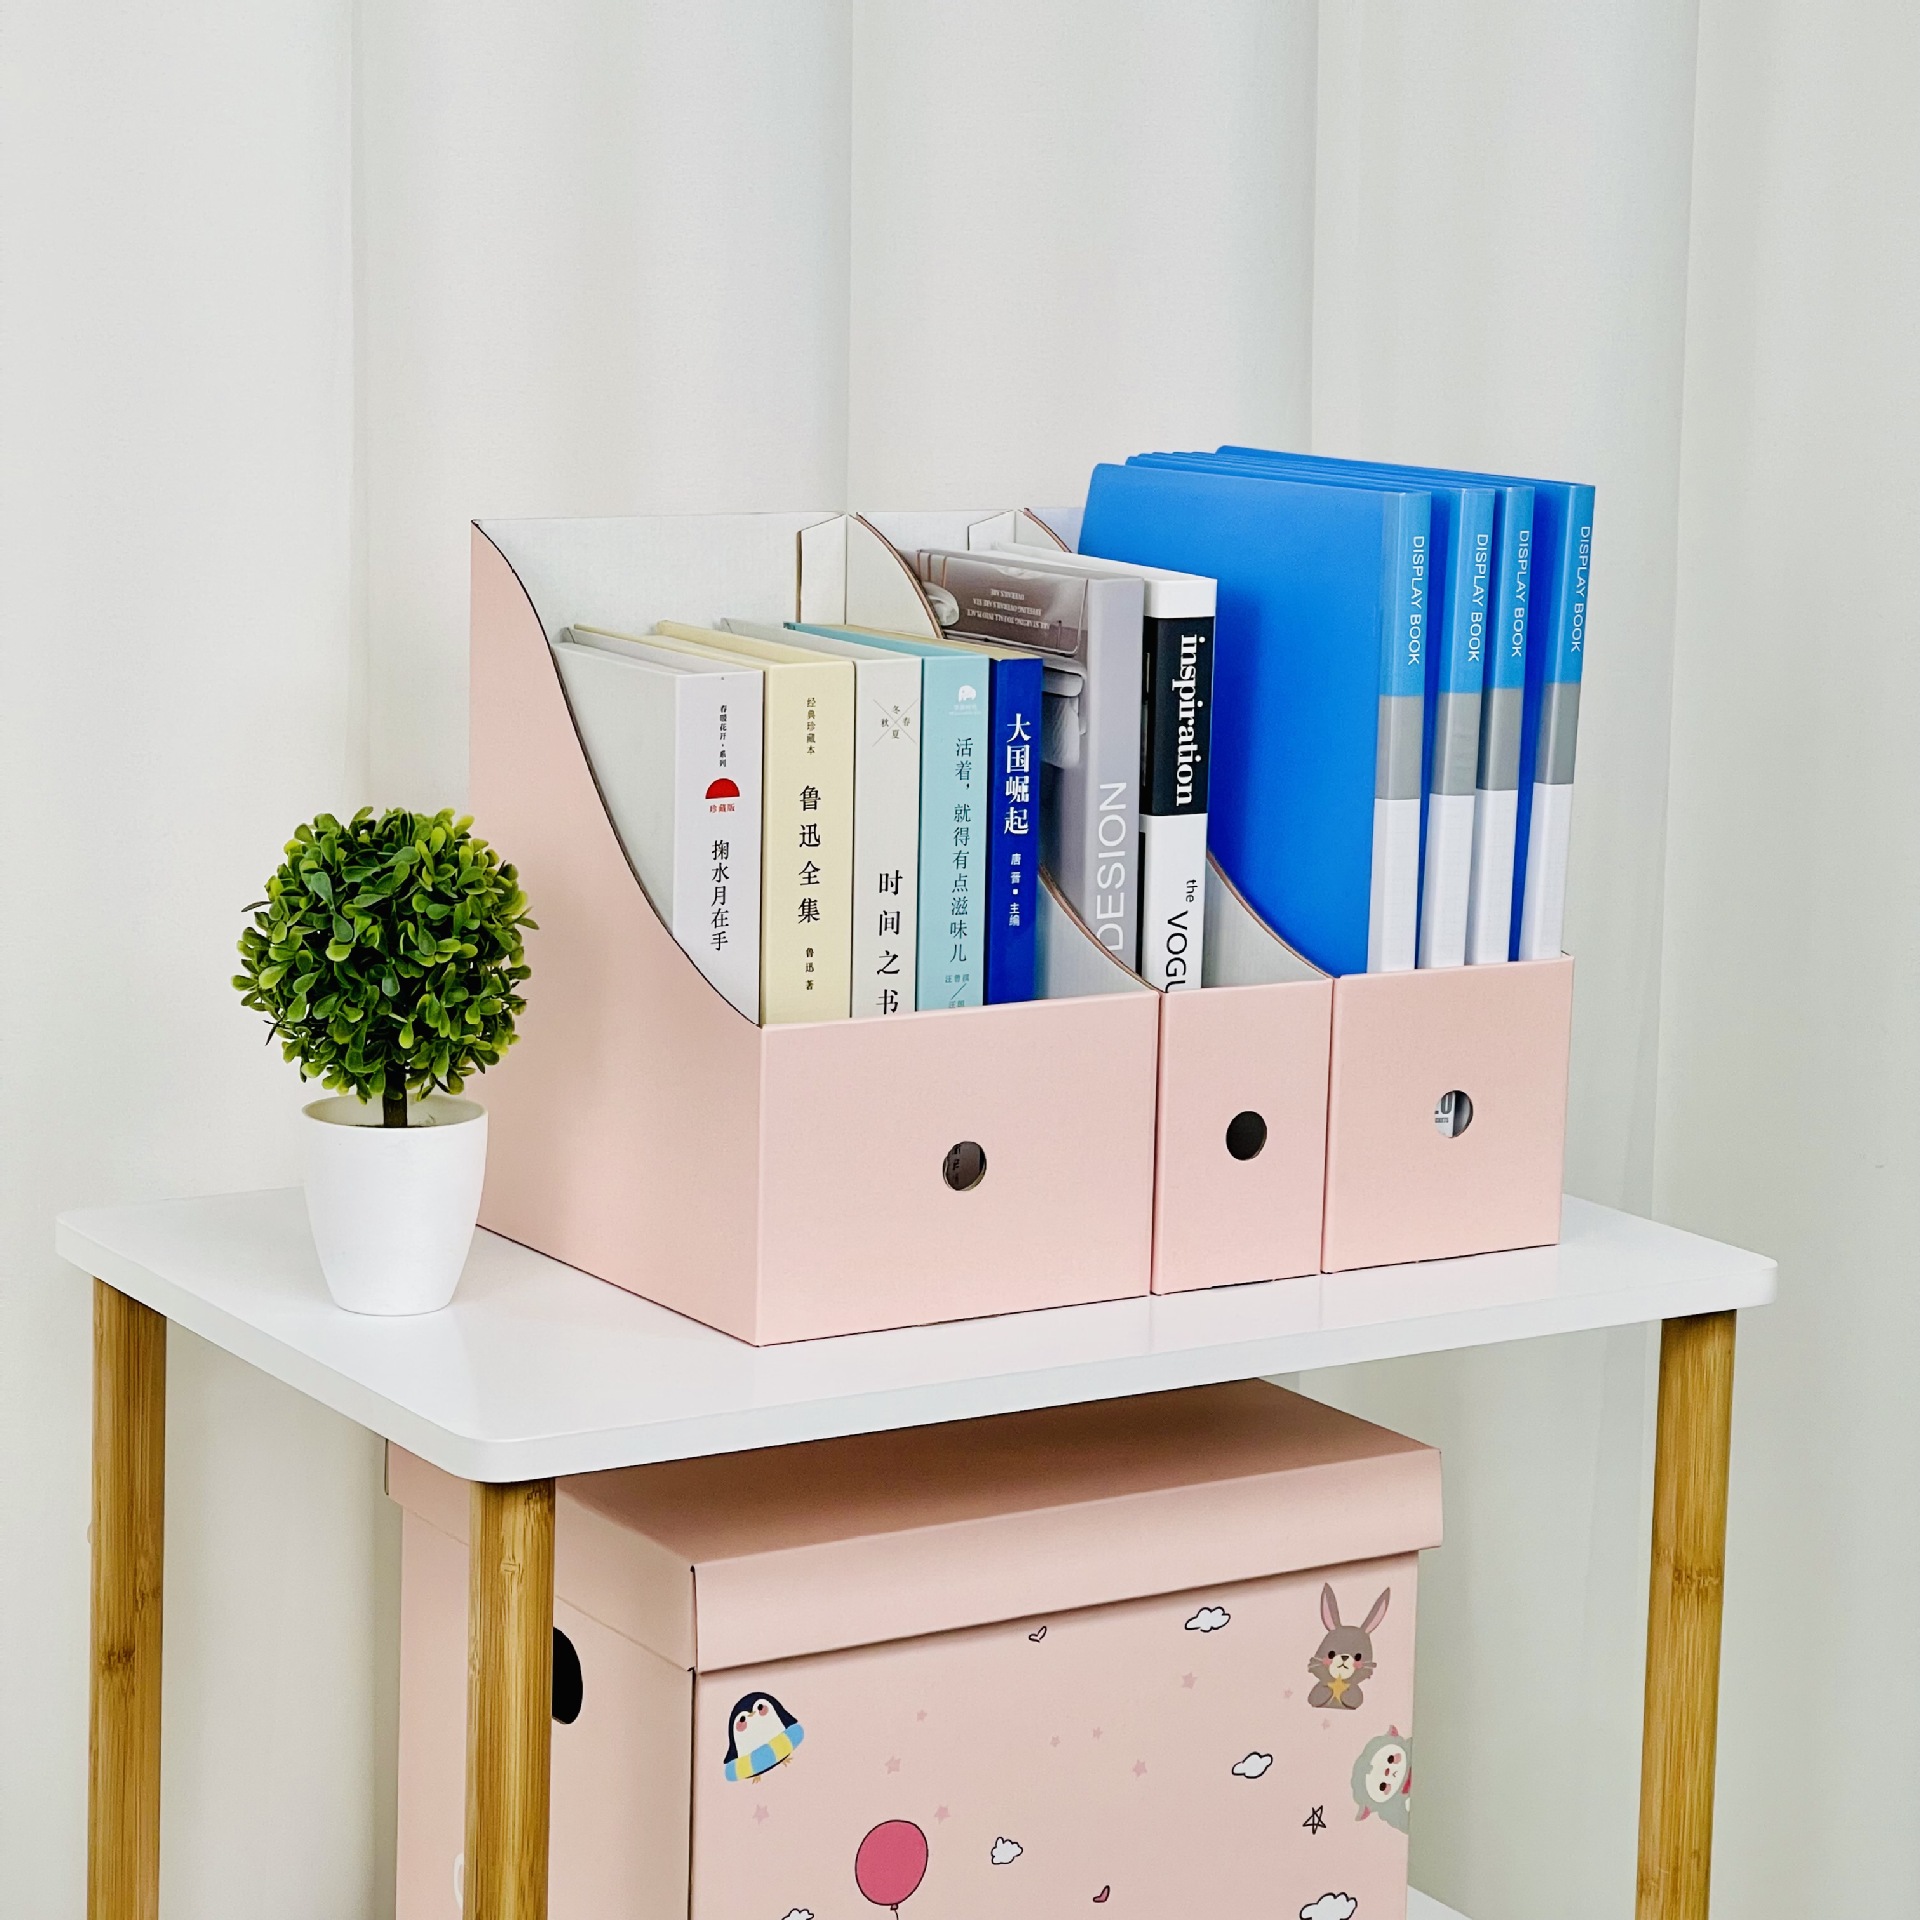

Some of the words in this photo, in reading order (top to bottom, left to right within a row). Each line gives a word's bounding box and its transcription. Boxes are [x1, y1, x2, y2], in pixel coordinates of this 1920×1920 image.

[1410, 536, 1425, 610] DISPLAY
[1471, 534, 1489, 607] DISPLAY
[1515, 530, 1530, 603] DISPLAY
[1575, 526, 1591, 598] DISPLAY
[1407, 614, 1422, 666] BOOK
[1467, 612, 1483, 662] BOOK
[1511, 607, 1525, 657] BOOK
[1570, 603, 1585, 653] BOOK
[806, 697, 817, 756] 经典珍藏本
[1172, 634, 1206, 807] inspiration
[1003, 712, 1031, 836] 大国崛起
[797, 785, 822, 924] 鲁迅全集
[1185, 879, 1198, 903] the
[710, 839, 730, 952] 掬水月在手
[876, 869, 903, 1015] 时间之书
